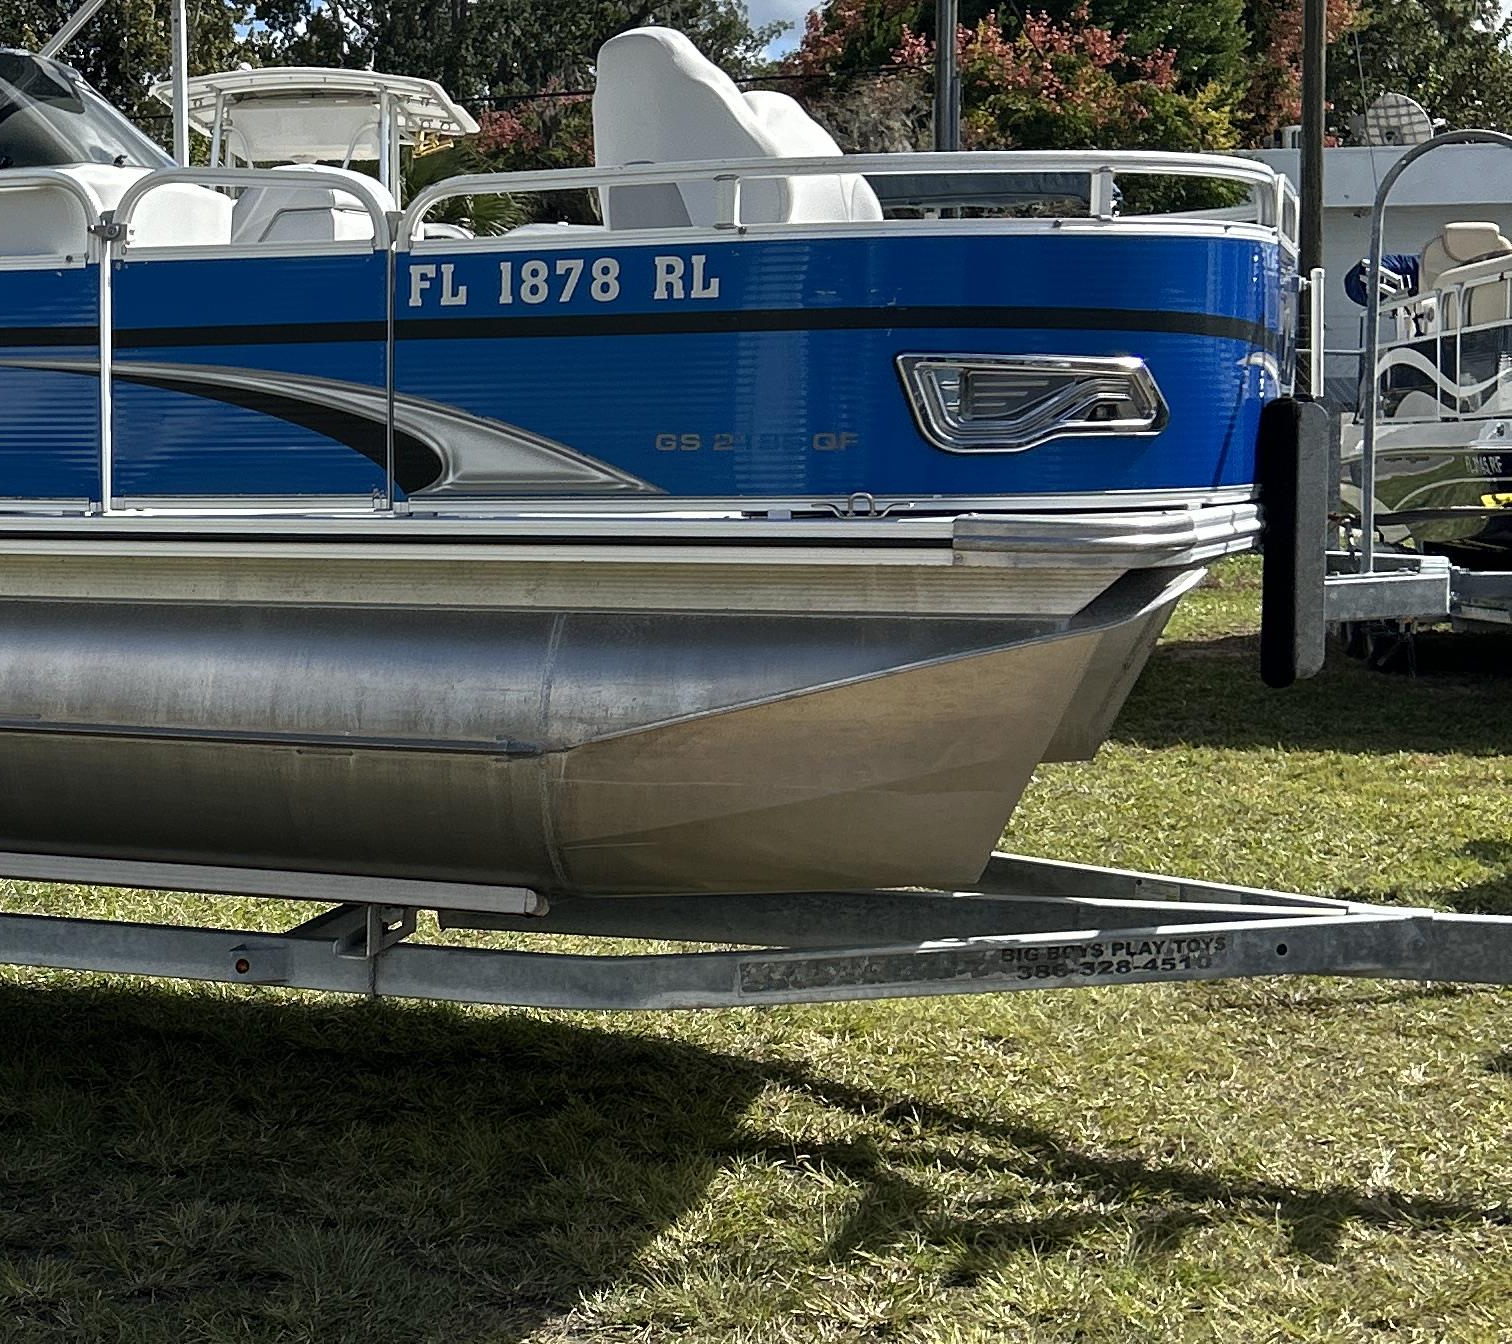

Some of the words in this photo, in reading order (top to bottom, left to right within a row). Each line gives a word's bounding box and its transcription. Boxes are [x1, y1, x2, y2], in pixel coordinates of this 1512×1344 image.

[408, 263, 467, 307] FL
[499, 257, 621, 305] 1878
[653, 254, 720, 300] RL
[655, 431, 701, 452] GS
[1001, 947, 1039, 963] BIG
[1111, 940, 1166, 958] PLAY
[1173, 936, 1226, 955] TOYS
